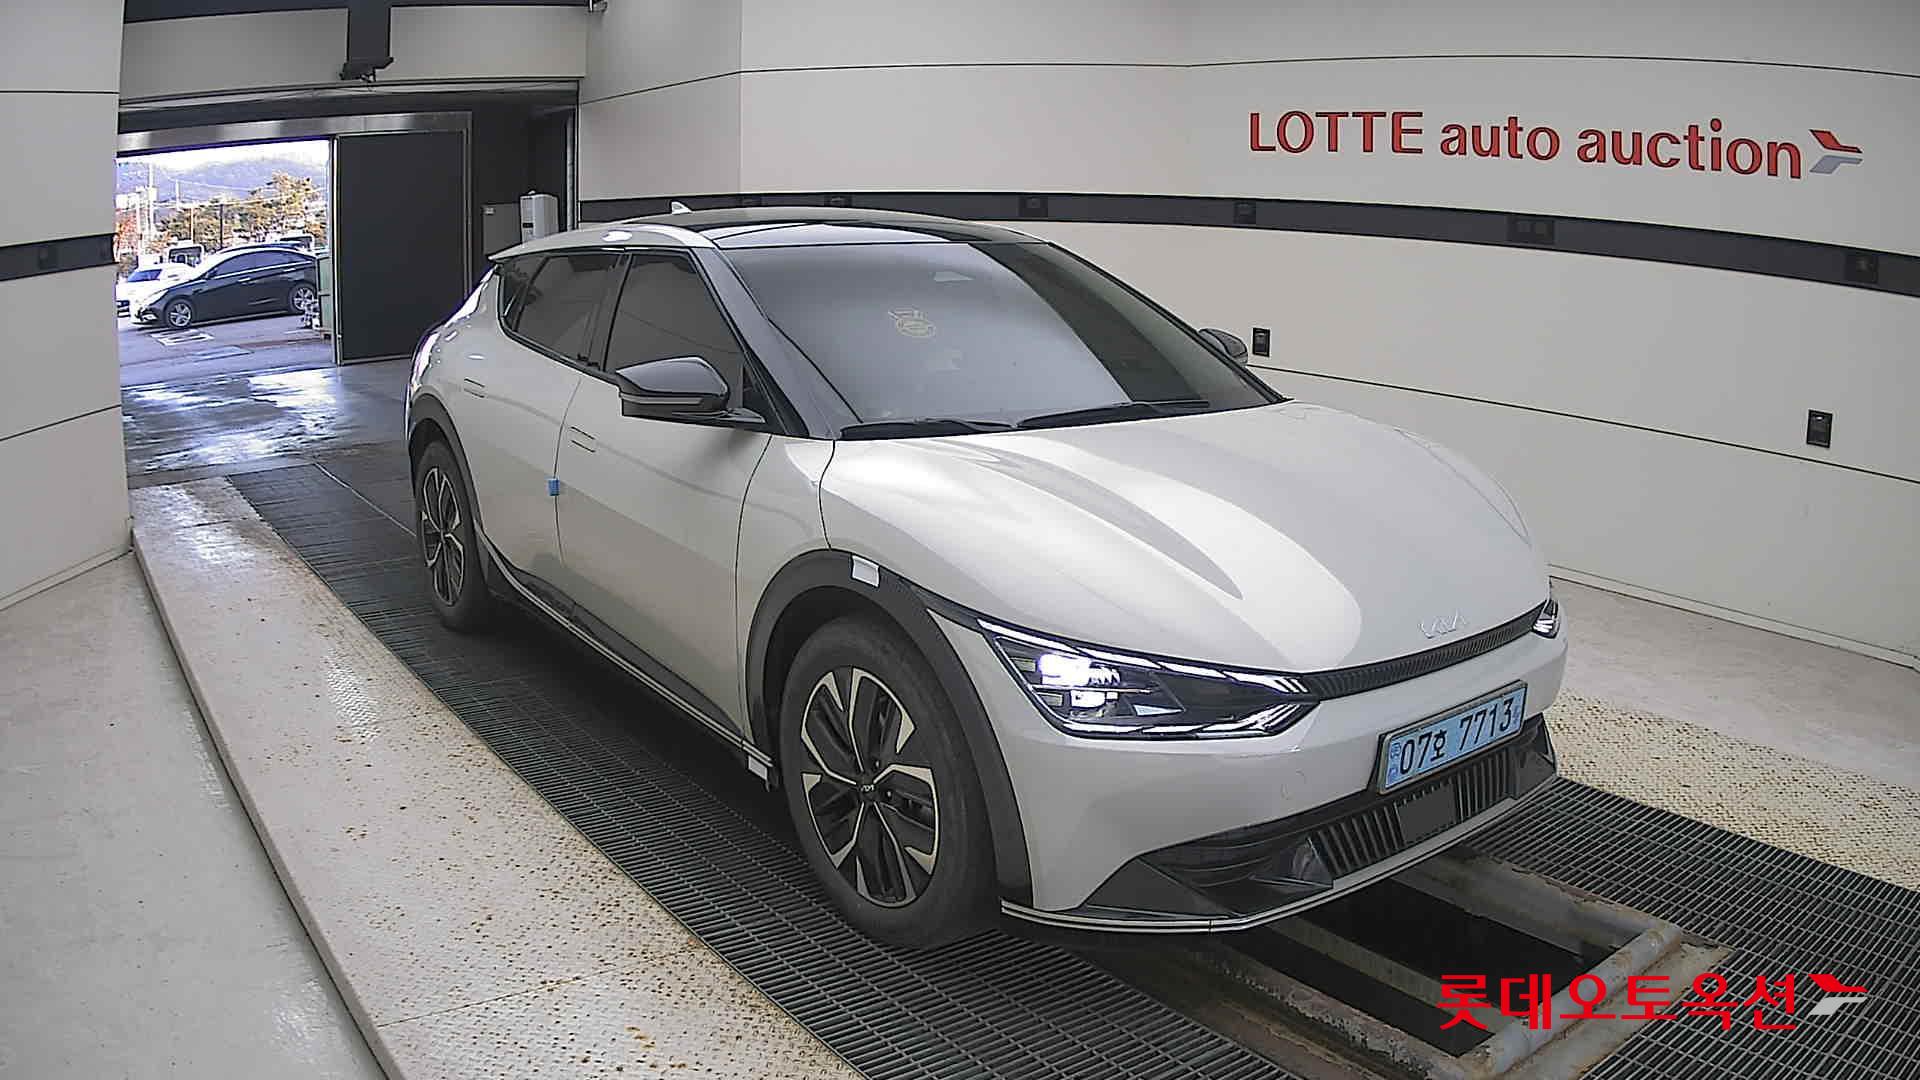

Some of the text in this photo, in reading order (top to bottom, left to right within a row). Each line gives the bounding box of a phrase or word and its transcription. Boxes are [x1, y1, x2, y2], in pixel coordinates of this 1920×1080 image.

[1249, 111, 1802, 179] LOTTE auto auction
[1400, 729, 1447, 775] 07호
[1459, 697, 1514, 751] 7713
